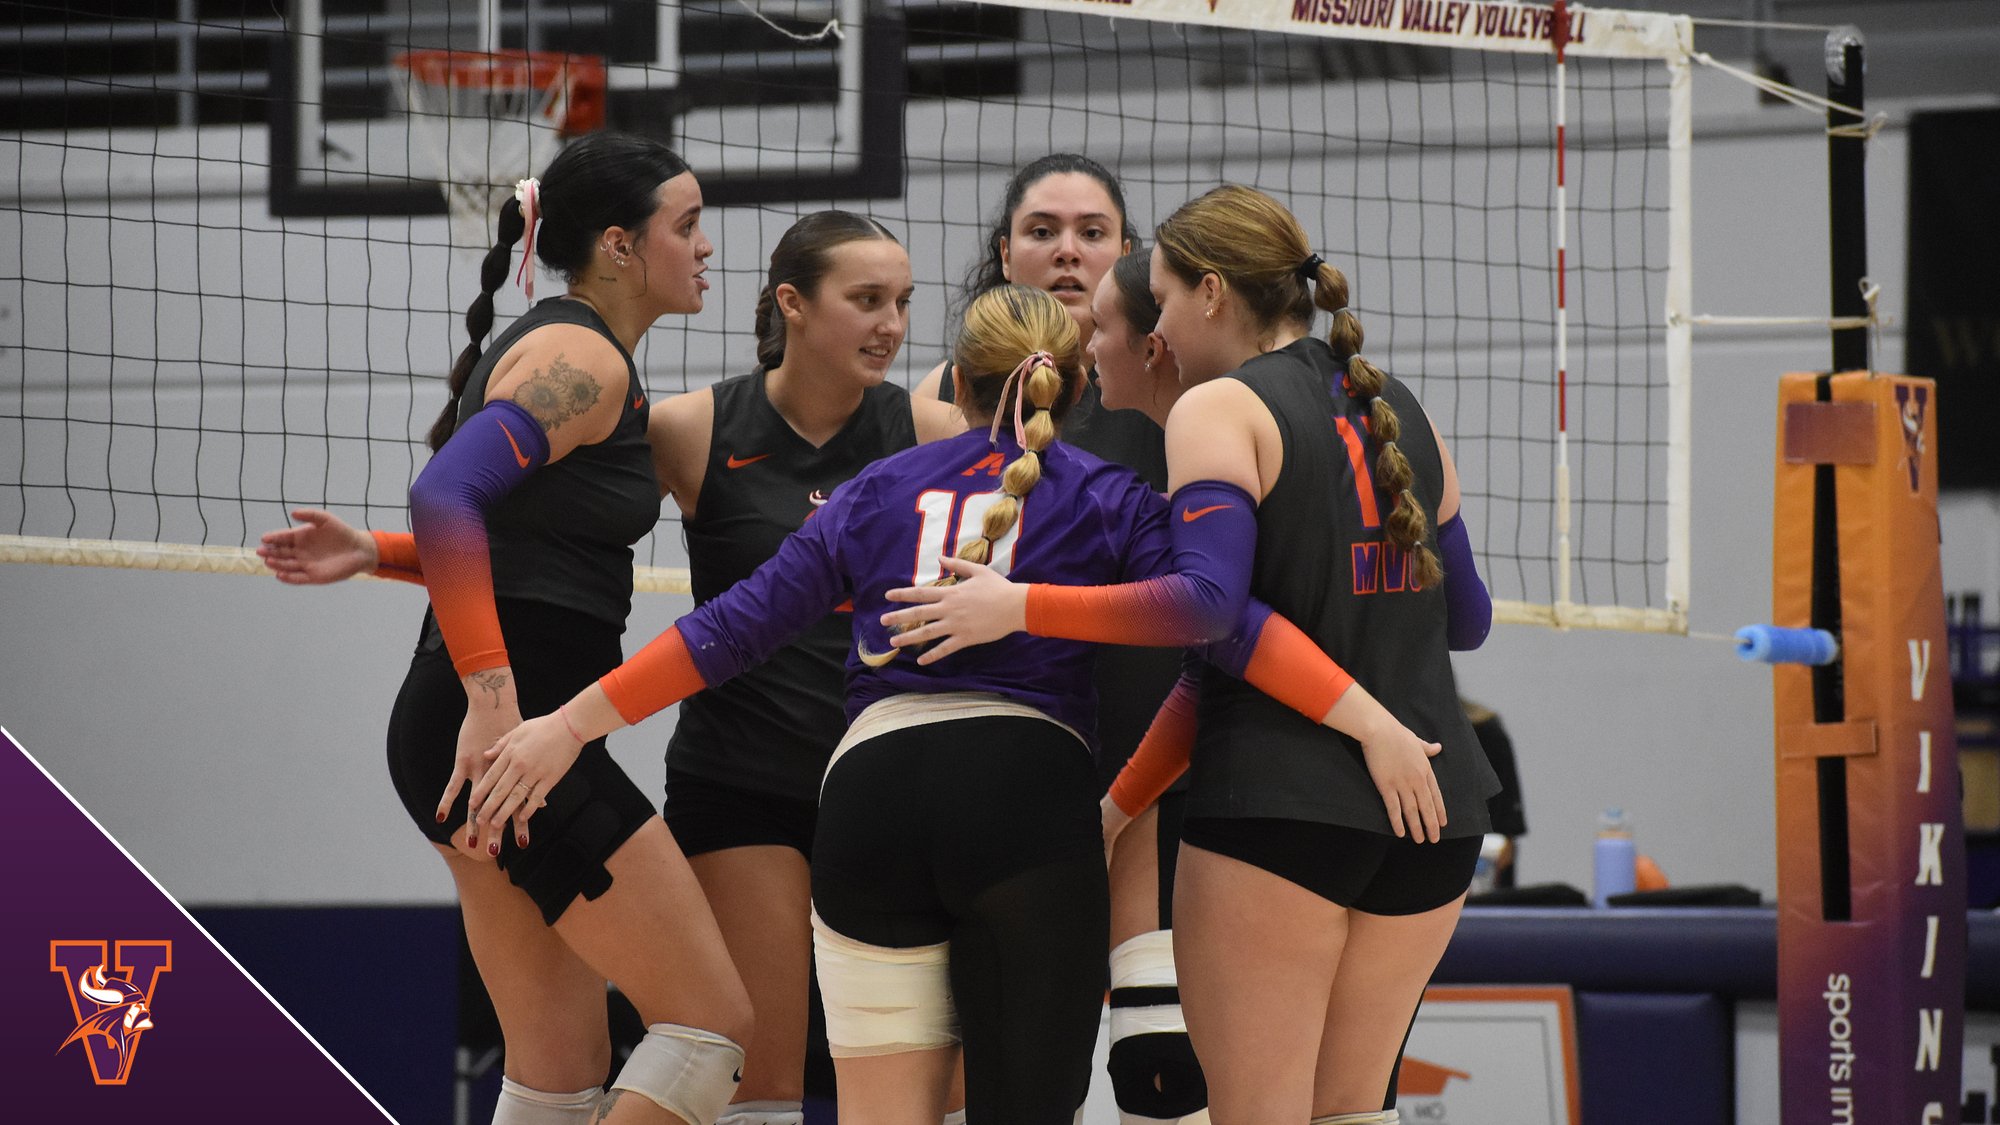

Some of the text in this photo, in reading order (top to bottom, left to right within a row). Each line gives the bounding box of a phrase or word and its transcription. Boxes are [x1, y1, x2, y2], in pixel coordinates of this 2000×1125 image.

[1291, 0, 1585, 43] MISSOURI VALLEY VOLLEYBLL
[1822, 973, 1856, 1082] sports
